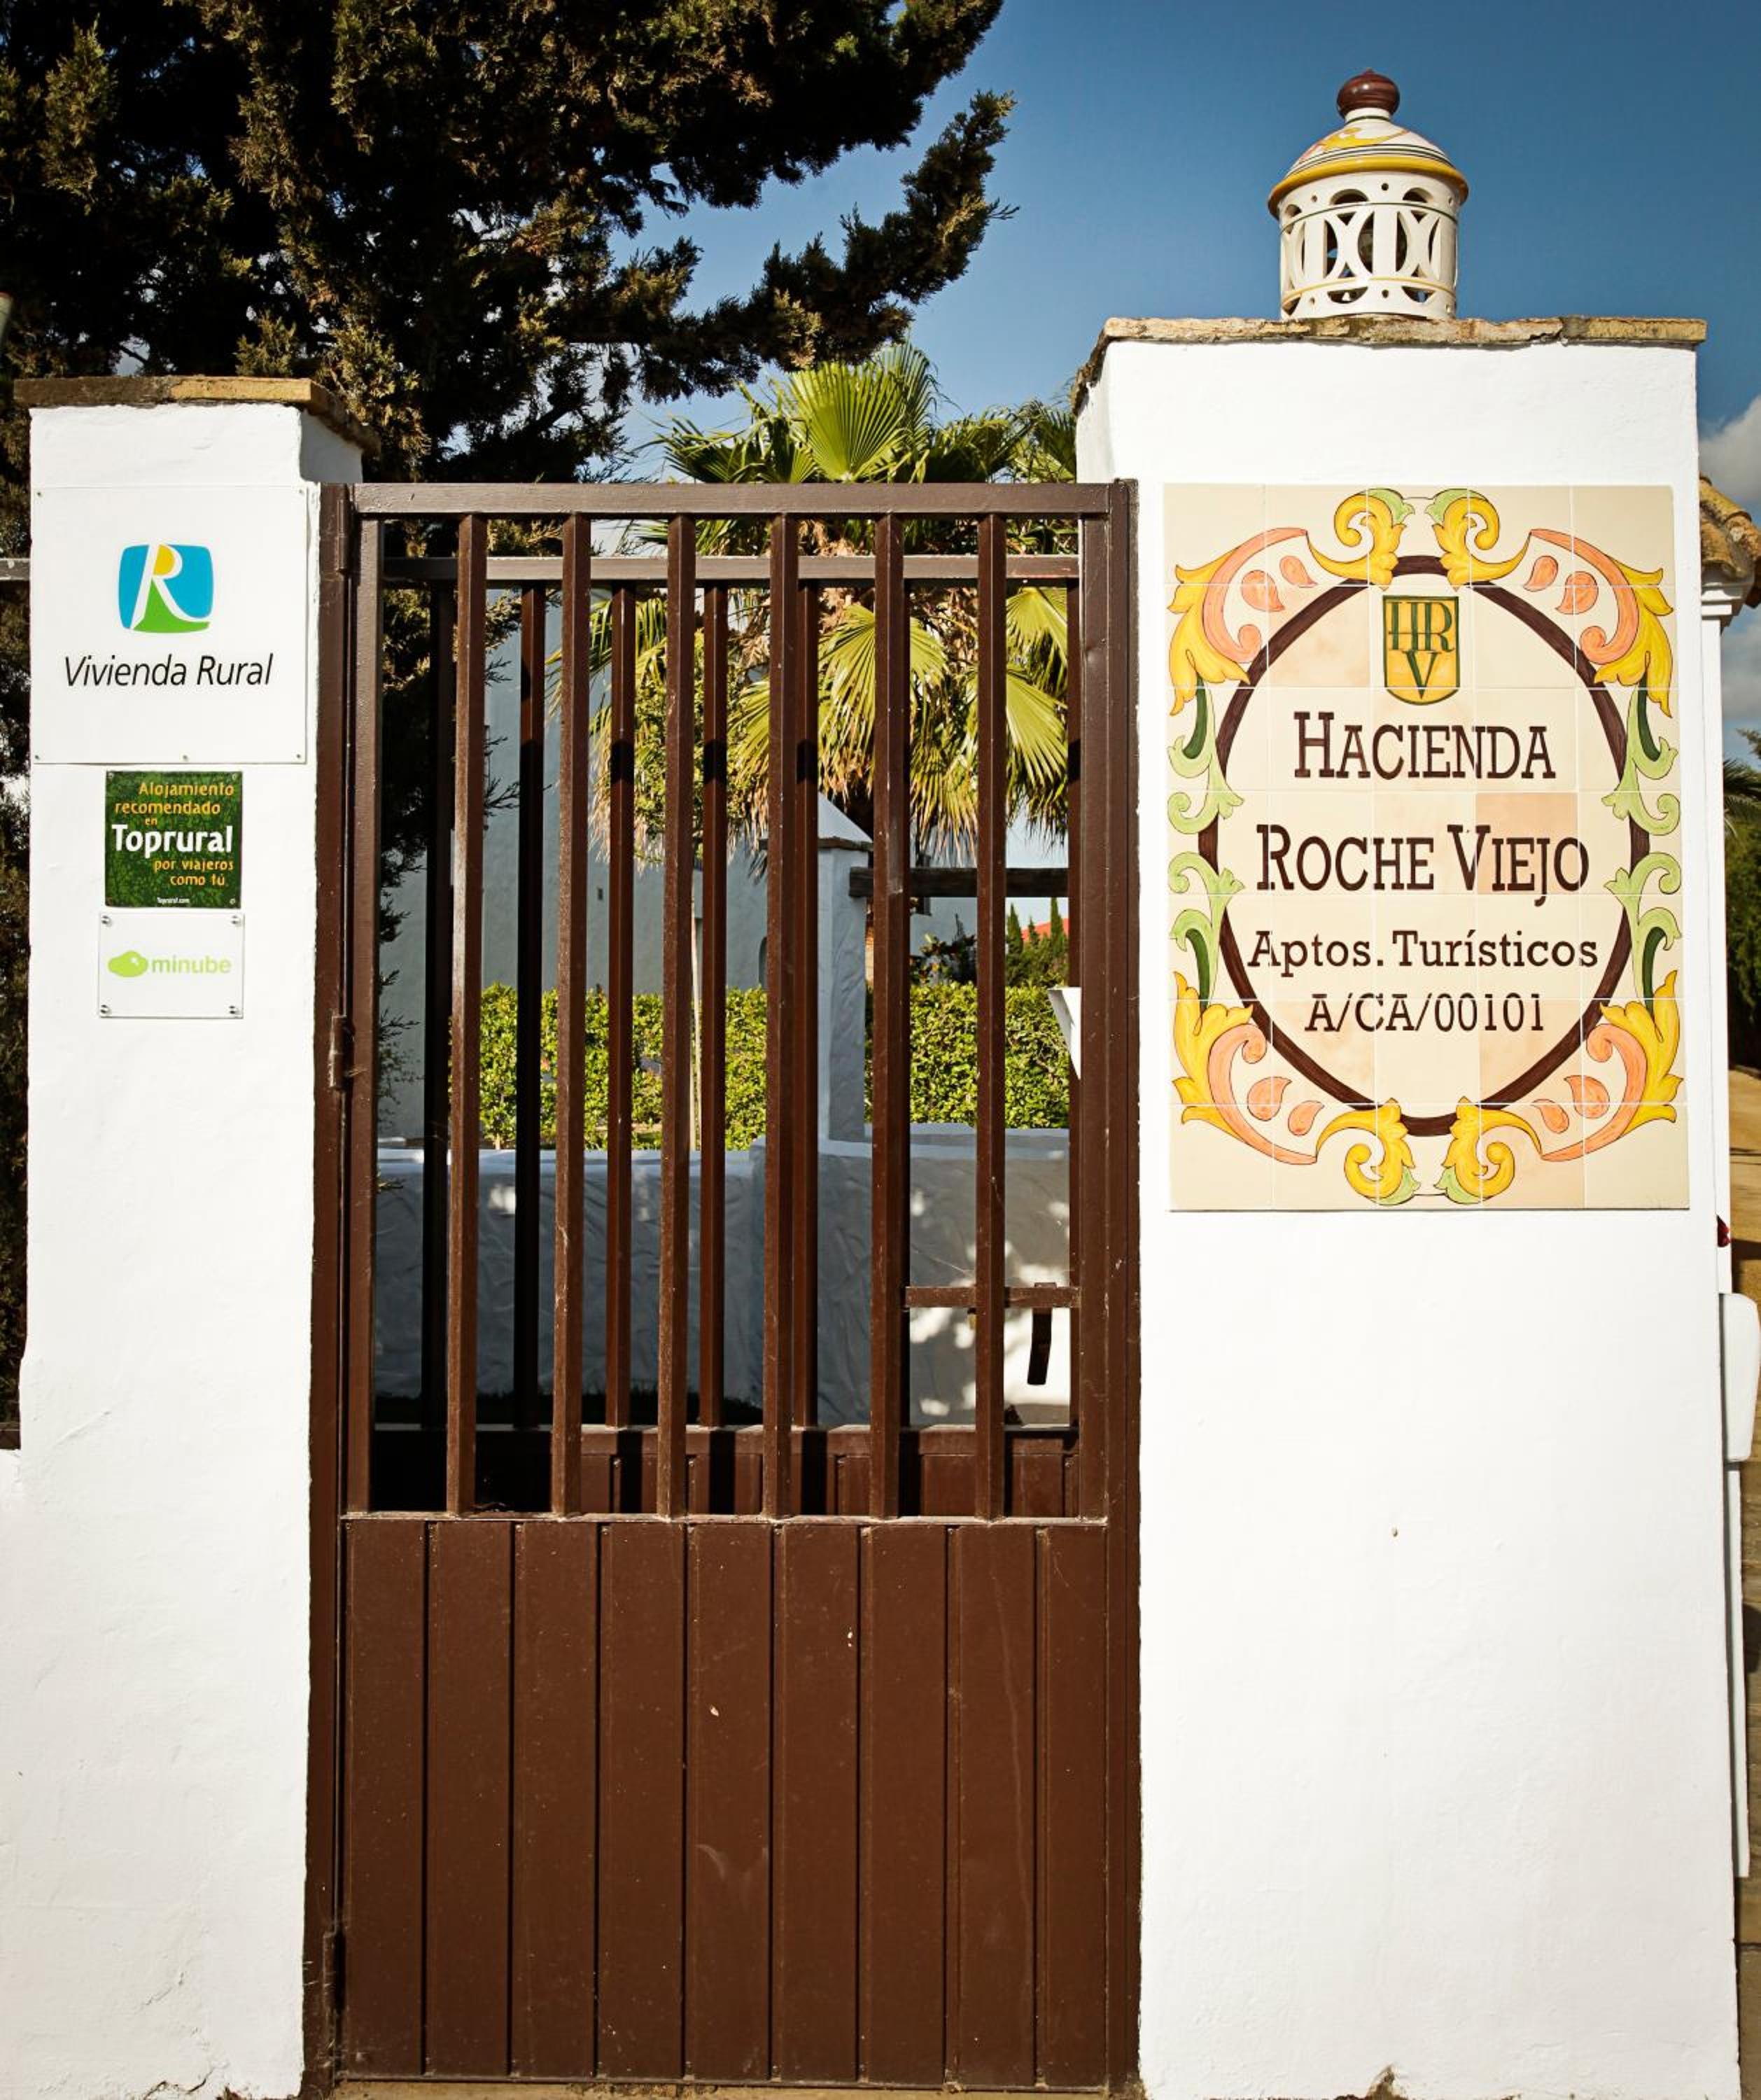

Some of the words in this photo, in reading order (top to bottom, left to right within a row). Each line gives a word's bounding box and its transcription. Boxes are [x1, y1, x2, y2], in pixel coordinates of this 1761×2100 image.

[65, 654, 187, 687] Vivienda
[196, 653, 274, 686] Rural
[1293, 711, 1556, 780] HACIENDA
[115, 801, 221, 814] recomendado
[139, 783, 234, 798] Alojamiento
[111, 824, 233, 859] Toprural
[153, 860, 175, 874] por
[181, 860, 234, 873] viajeros
[170, 876, 206, 886] como
[211, 874, 225, 886] tú
[1256, 824, 1434, 892] ROCHE
[1447, 824, 1590, 908] VIEJO
[152, 955, 232, 974] minube
[1247, 931, 1383, 979] Aptos.
[1392, 930, 1599, 969] Turísticos
[1305, 993, 1544, 1033] A/CA/00101
